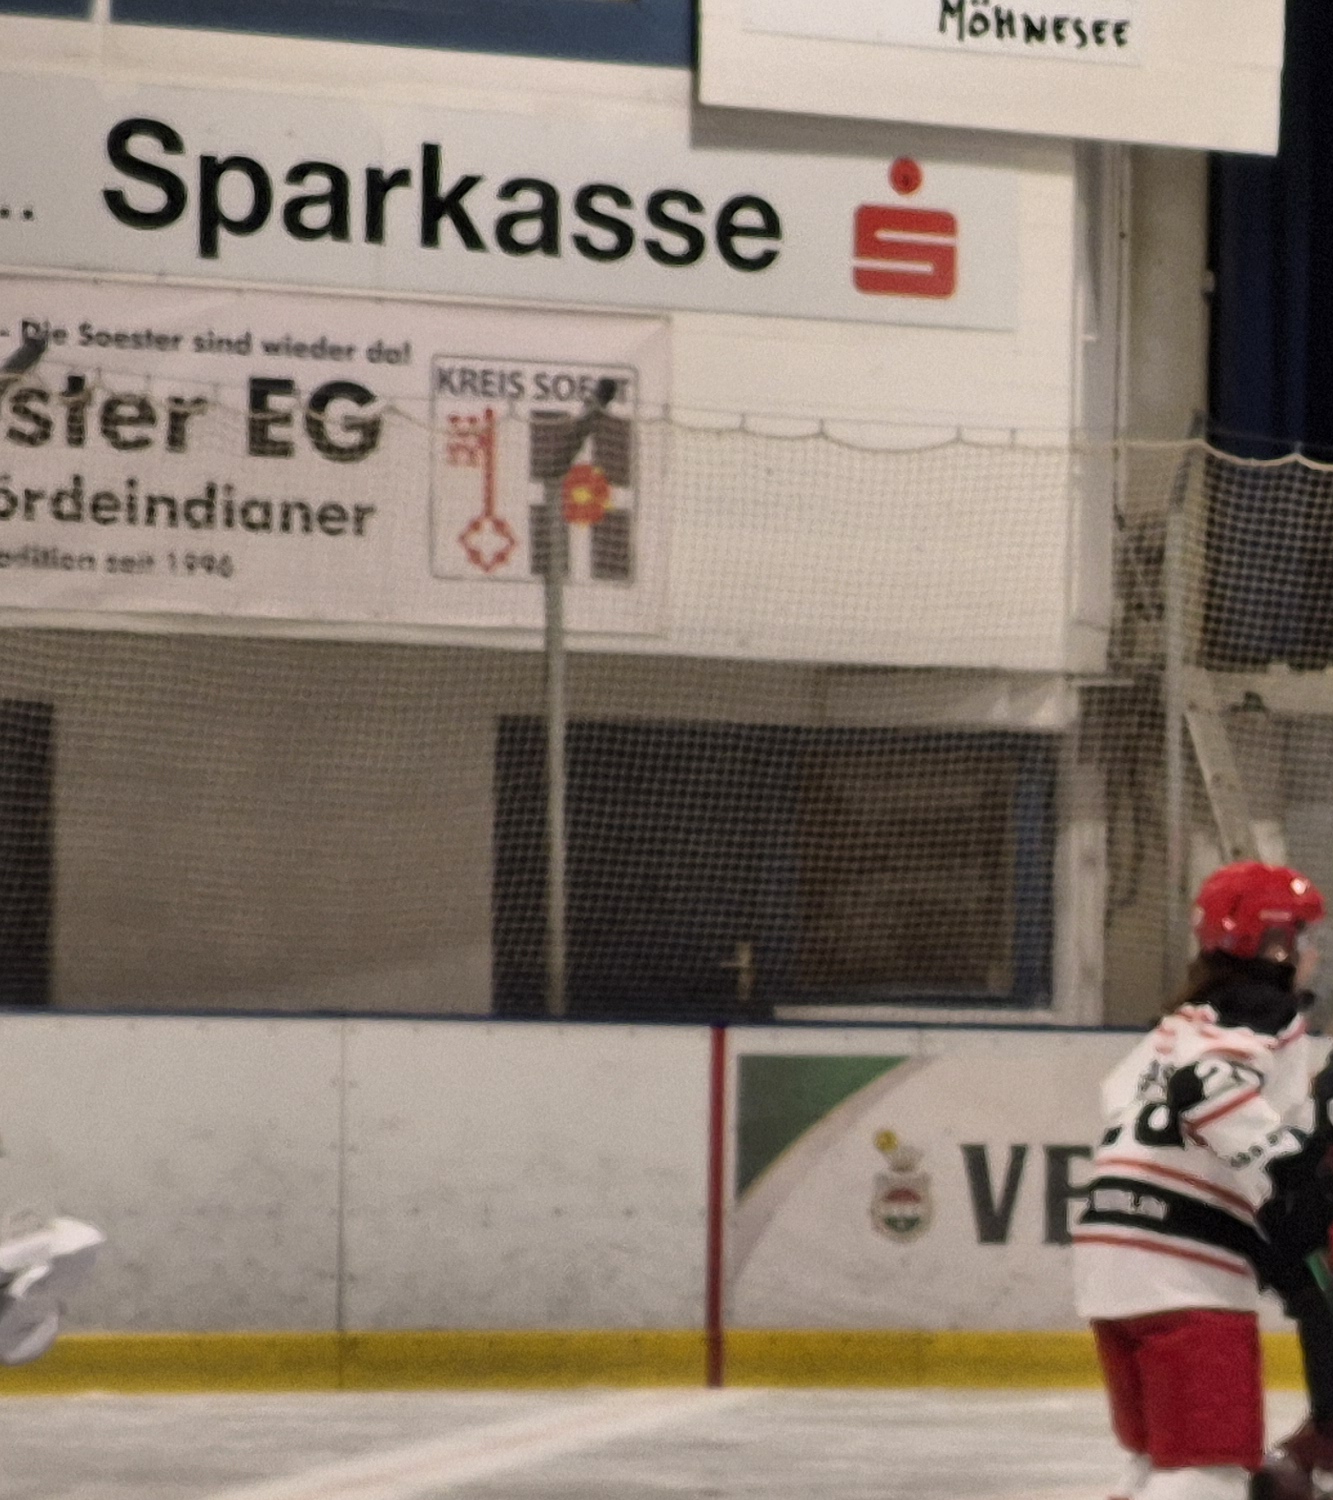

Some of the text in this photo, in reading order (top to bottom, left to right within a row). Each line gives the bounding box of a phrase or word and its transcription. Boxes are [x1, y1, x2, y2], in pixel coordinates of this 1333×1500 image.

[102, 117, 783, 272] Sparkasse
[78, 320, 184, 350] Soester
[193, 331, 252, 356] sind
[262, 333, 357, 361] wieder
[366, 338, 412, 364] da!
[436, 367, 630, 404] KREIS SOET
[248, 376, 383, 463] EG
